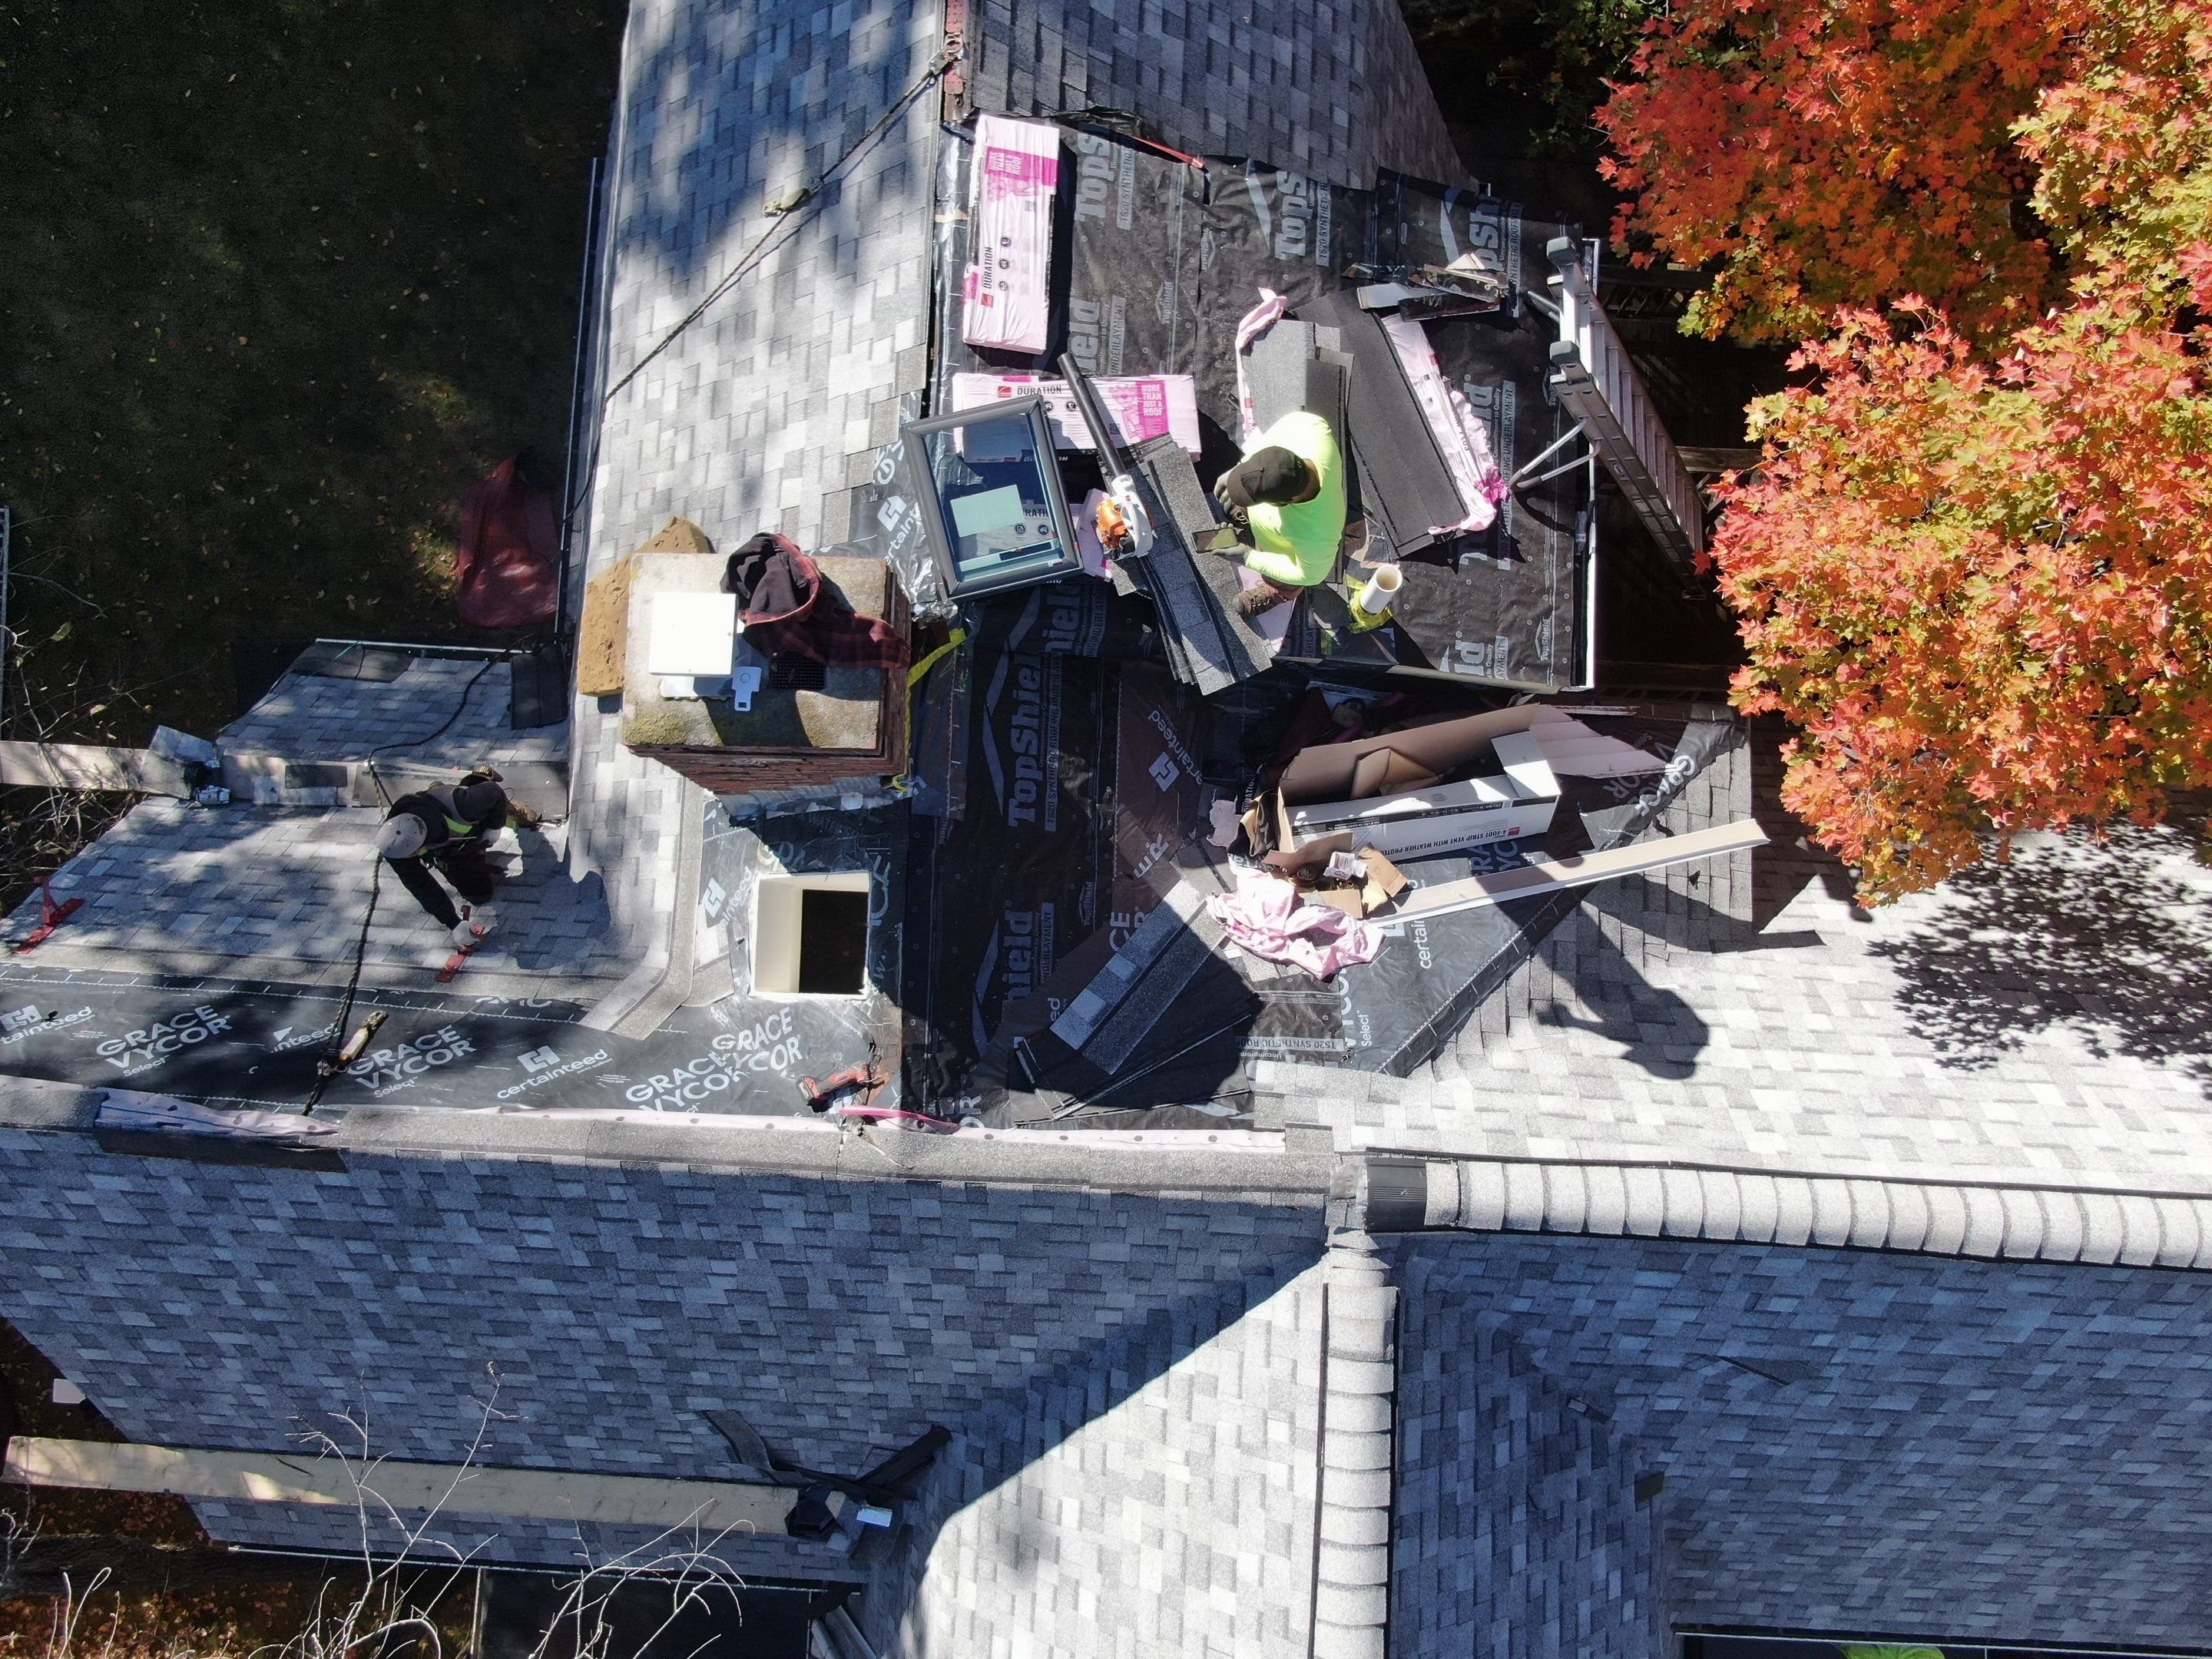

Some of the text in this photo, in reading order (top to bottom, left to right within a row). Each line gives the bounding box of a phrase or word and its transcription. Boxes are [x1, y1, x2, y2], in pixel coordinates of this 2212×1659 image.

[984, 247, 993, 289] DURATION
[1318, 237, 1327, 259] TS20
[1017, 386, 1062, 396] DURATION
[1143, 392, 1162, 400] THAN
[1143, 407, 1163, 416] ROOF
[1502, 389, 1514, 455] UNDERLAYMENT
[1541, 618, 1551, 661] TopShield
[1008, 654, 1043, 827] TopShiel
[1050, 707, 1060, 746] ROOFING
[1048, 750, 1058, 798] SYNTHETIC
[1047, 800, 1055, 823] TS20
[1405, 843, 1432, 852] WEATHER
[1466, 833, 1484, 841] STRIP
[96, 1005, 219, 1056] GRACE
[105, 1016, 232, 1068] VYCOR
[712, 1006, 793, 1050] GRACE
[1262, 1038, 1312, 1049] SYNTHETIC
[1313, 1041, 1336, 1049] TS20
[346, 1025, 461, 1075] GRACE
[356, 1040, 477, 1088] VYCOR
[496, 1049, 608, 1100] certainteed
